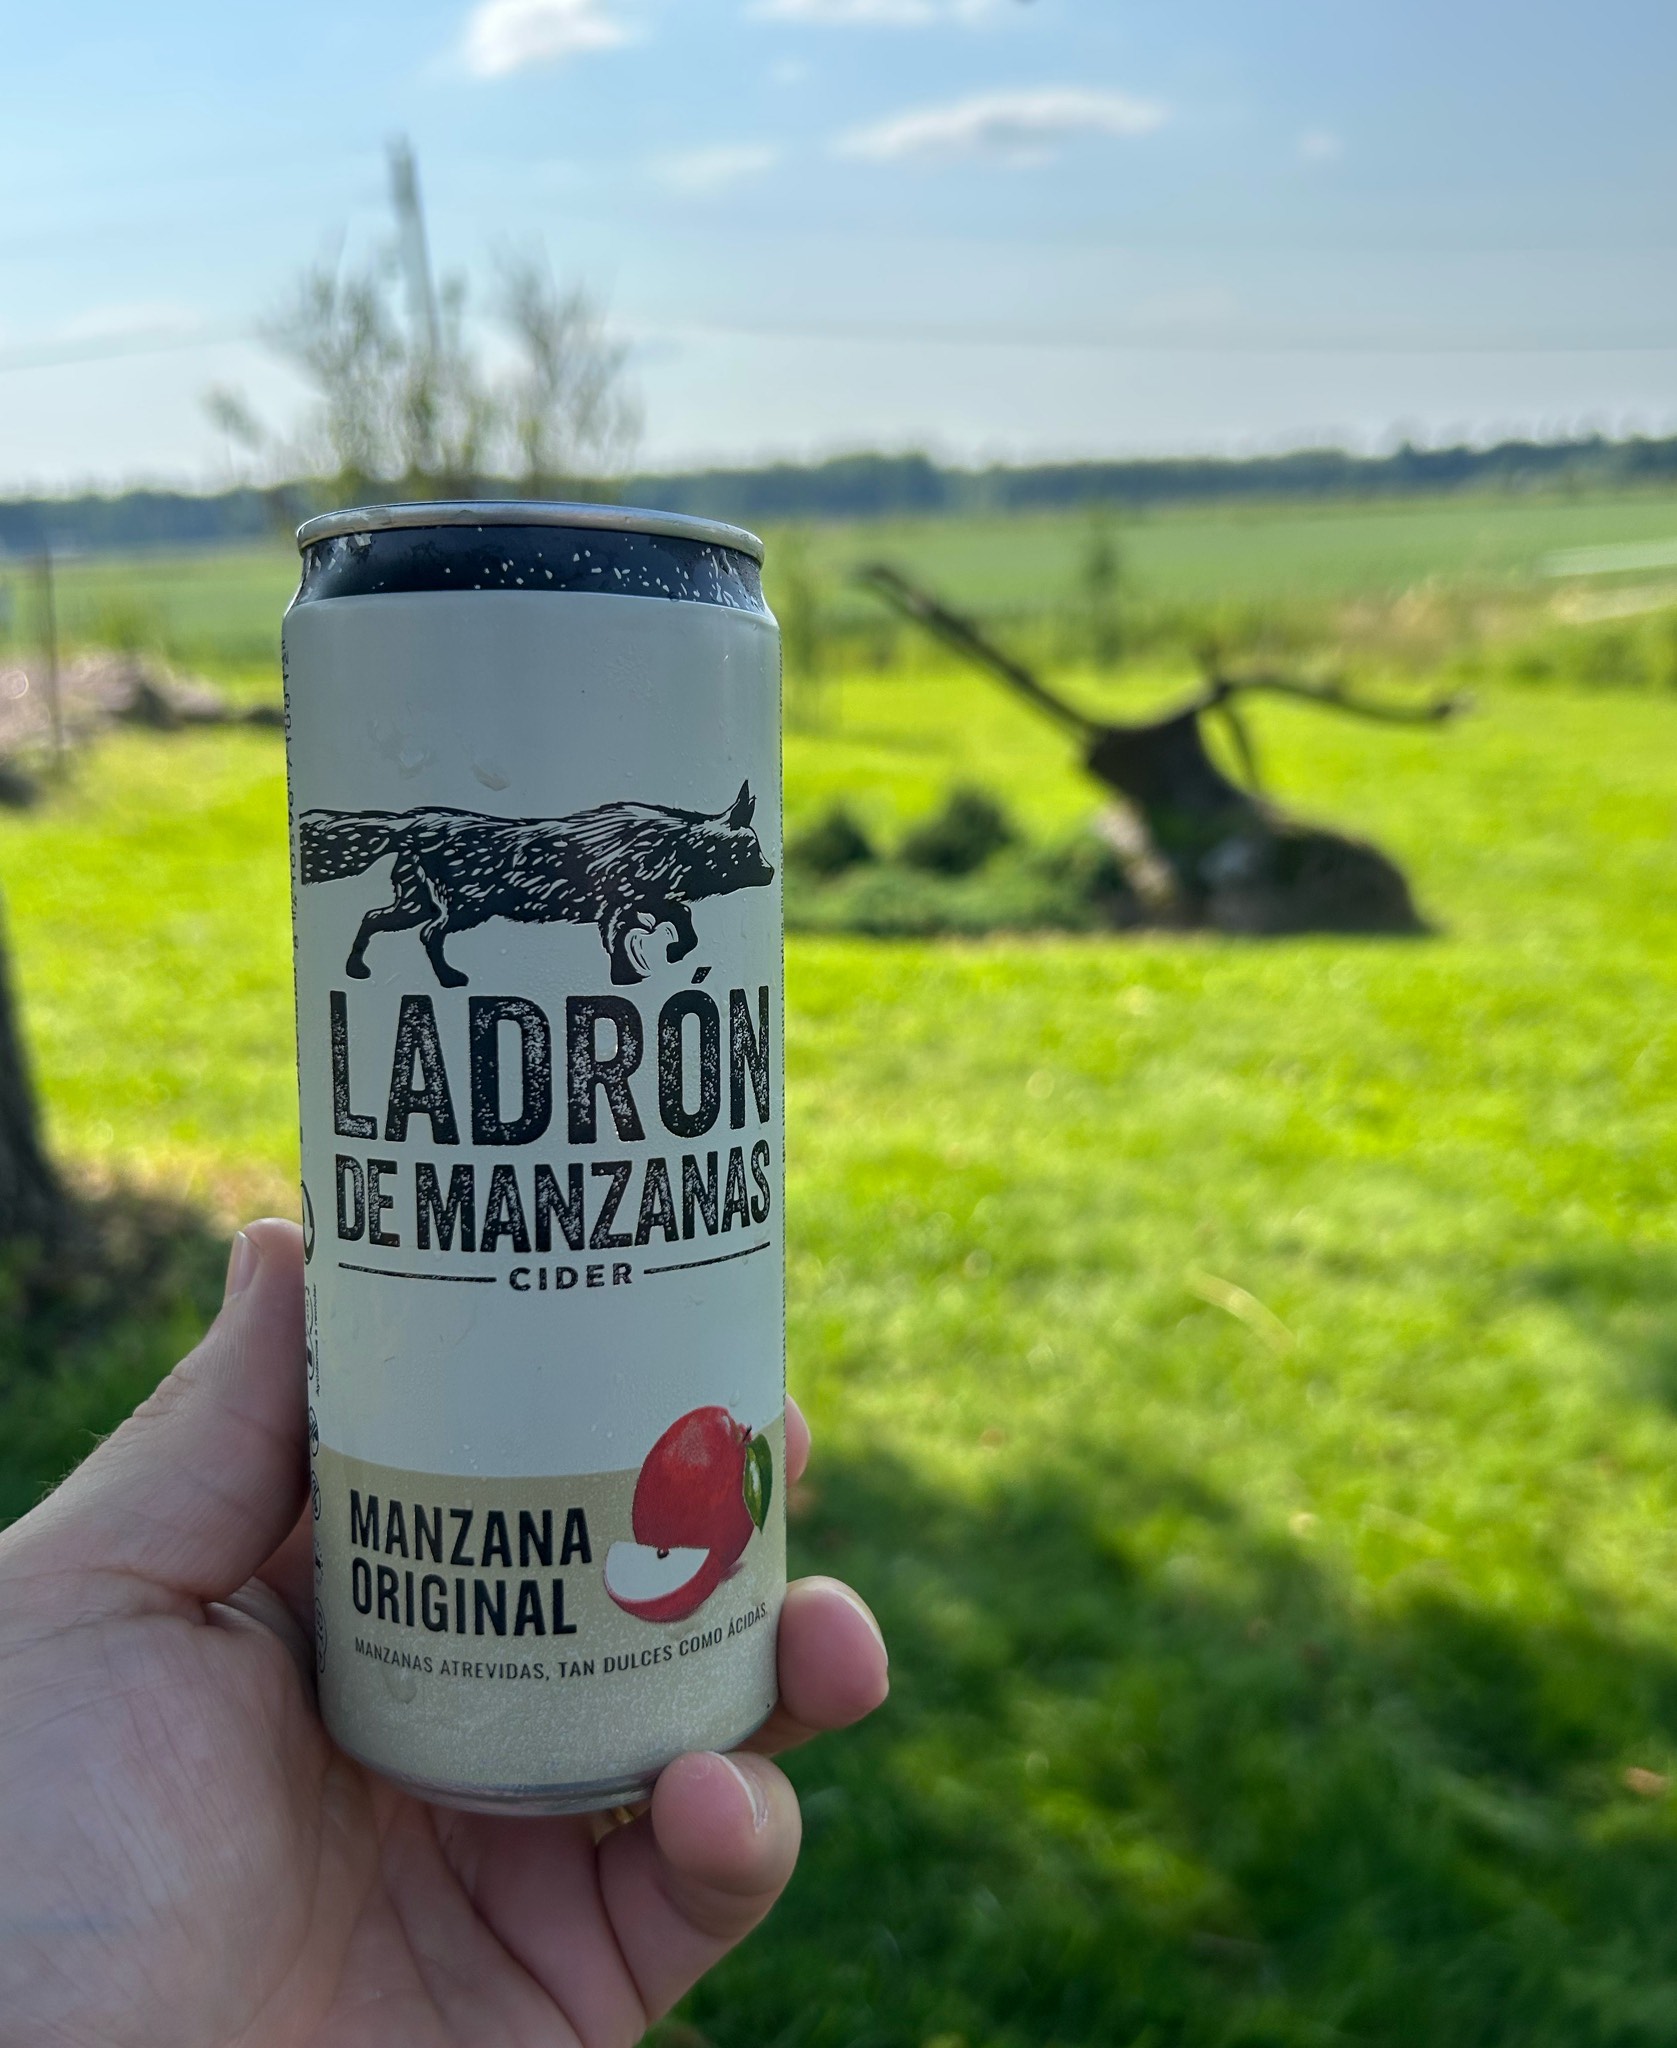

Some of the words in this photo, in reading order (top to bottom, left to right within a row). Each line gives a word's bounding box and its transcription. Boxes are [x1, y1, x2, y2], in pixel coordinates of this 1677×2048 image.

[330, 966, 770, 1146] LADRÓN
[335, 1154, 399, 1248] DE
[415, 1140, 771, 1253] MANZANAS
[509, 1262, 633, 1292] CIDER
[350, 1488, 593, 1568] MANZANA
[351, 1557, 578, 1636] ORIGINAL
[355, 1636, 433, 1674] MANZANAS
[440, 1659, 551, 1681] ATREVIDAS,
[558, 1659, 595, 1679] TAN
[603, 1644, 673, 1674] DULCES
[679, 1627, 723, 1657] COMO
